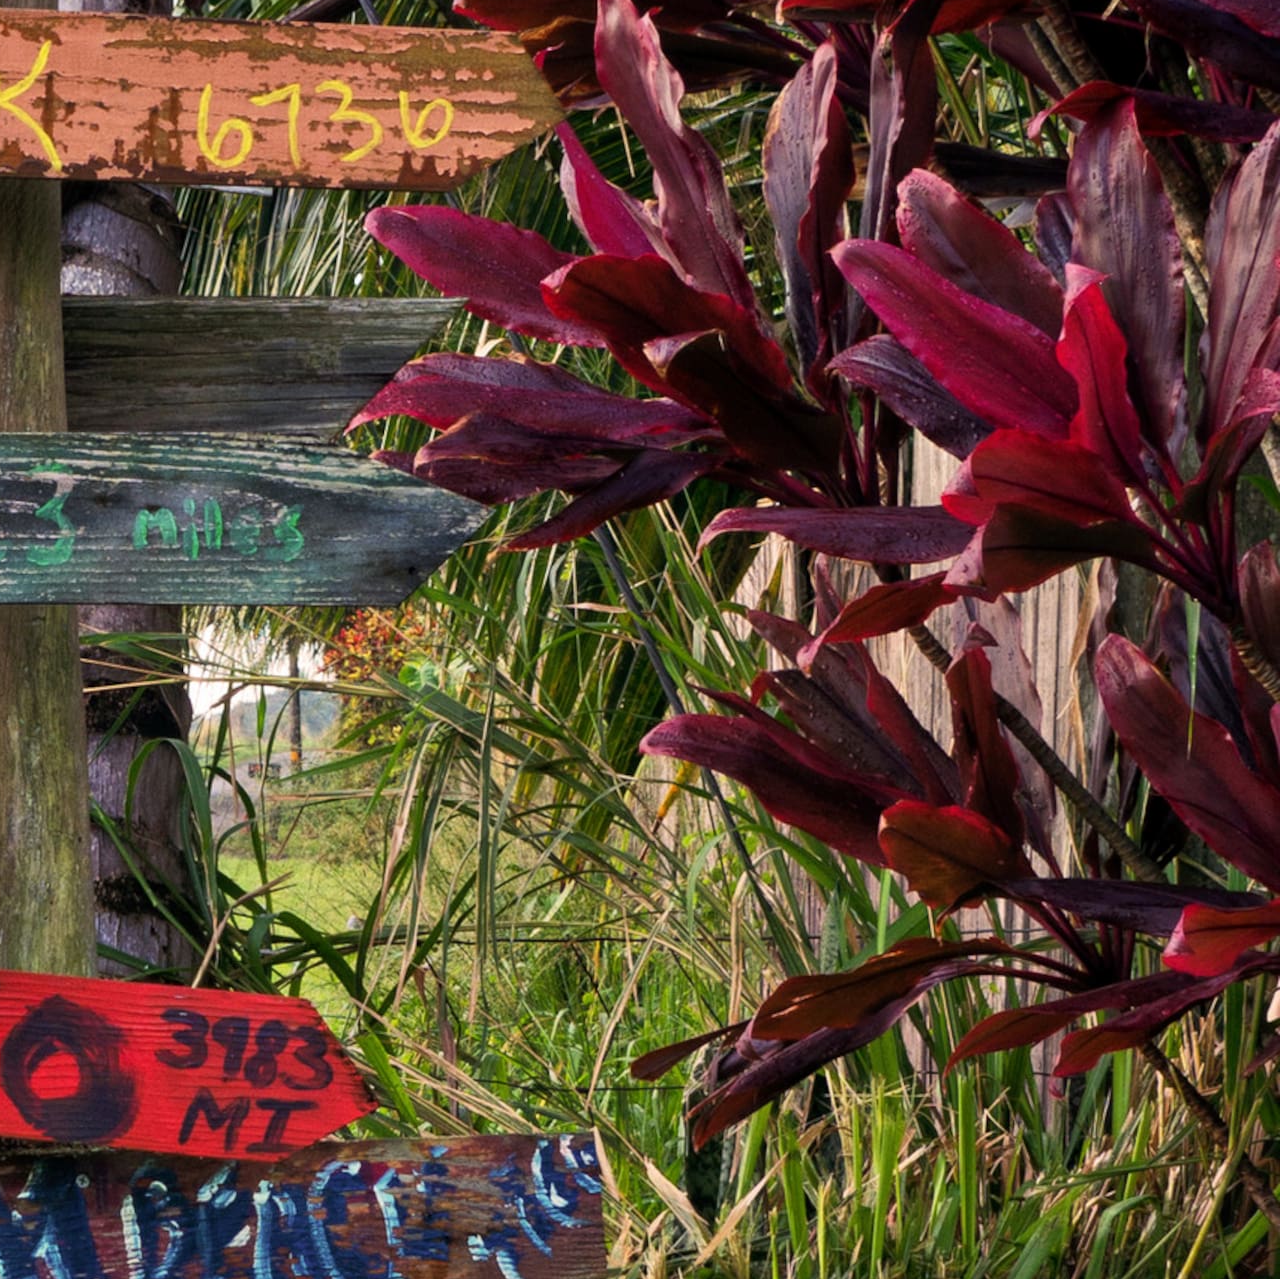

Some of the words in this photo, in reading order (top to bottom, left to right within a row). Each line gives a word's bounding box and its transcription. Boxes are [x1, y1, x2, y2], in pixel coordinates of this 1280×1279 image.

[197, 78, 455, 171] 6736
[154, 1007, 334, 1091] 3983
[177, 1085, 320, 1153] MI
